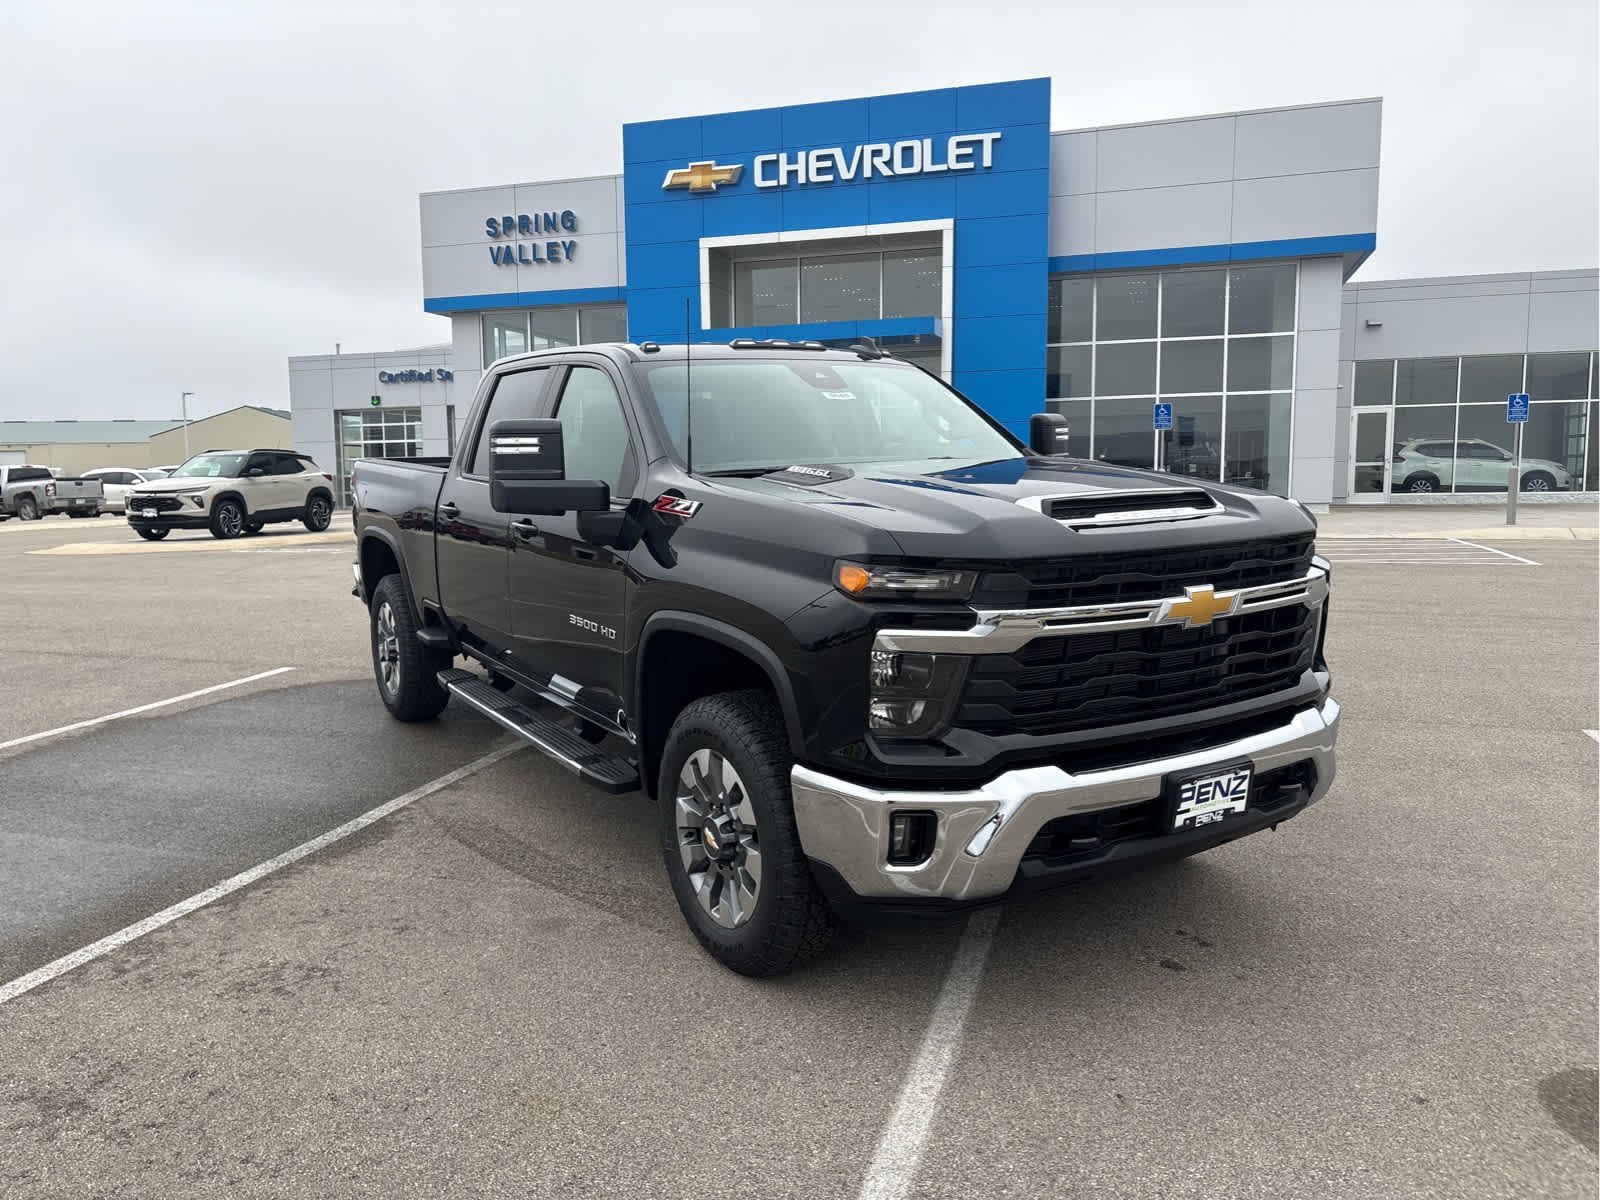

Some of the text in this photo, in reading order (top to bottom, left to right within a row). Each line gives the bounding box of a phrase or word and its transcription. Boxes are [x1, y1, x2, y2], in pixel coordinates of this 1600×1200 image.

[753, 131, 1002, 188] CHEVROLET
[485, 209, 577, 239] SPRING
[488, 239, 577, 265] VALLEY
[378, 369, 433, 384] Certified
[652, 494, 701, 518] Z71
[569, 614, 616, 640] 3500 HD
[1179, 774, 1248, 804] PENZ
